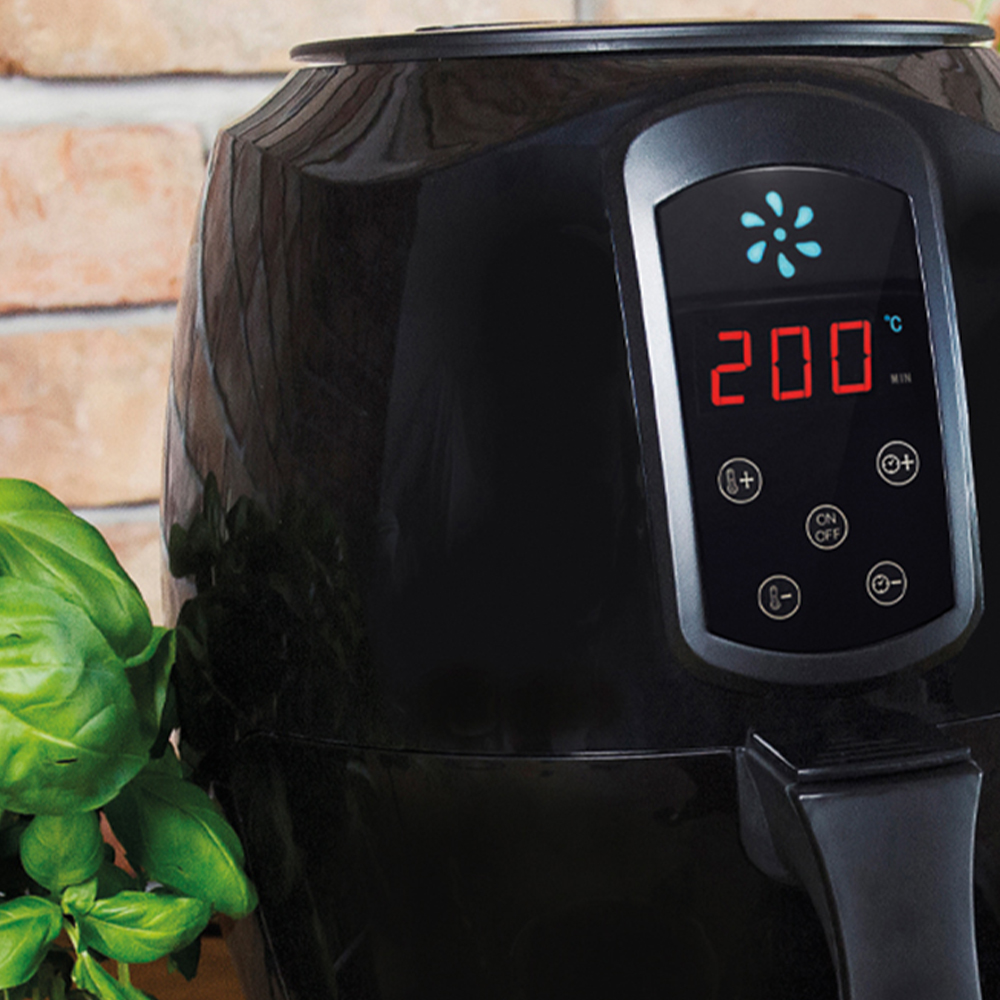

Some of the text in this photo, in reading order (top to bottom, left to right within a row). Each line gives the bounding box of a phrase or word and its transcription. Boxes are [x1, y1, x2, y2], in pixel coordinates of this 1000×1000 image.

[710, 319, 872, 406] 200
[890, 372, 912, 384] MIN
[815, 512, 837, 527] ON
[814, 527, 840, 543] OFF
